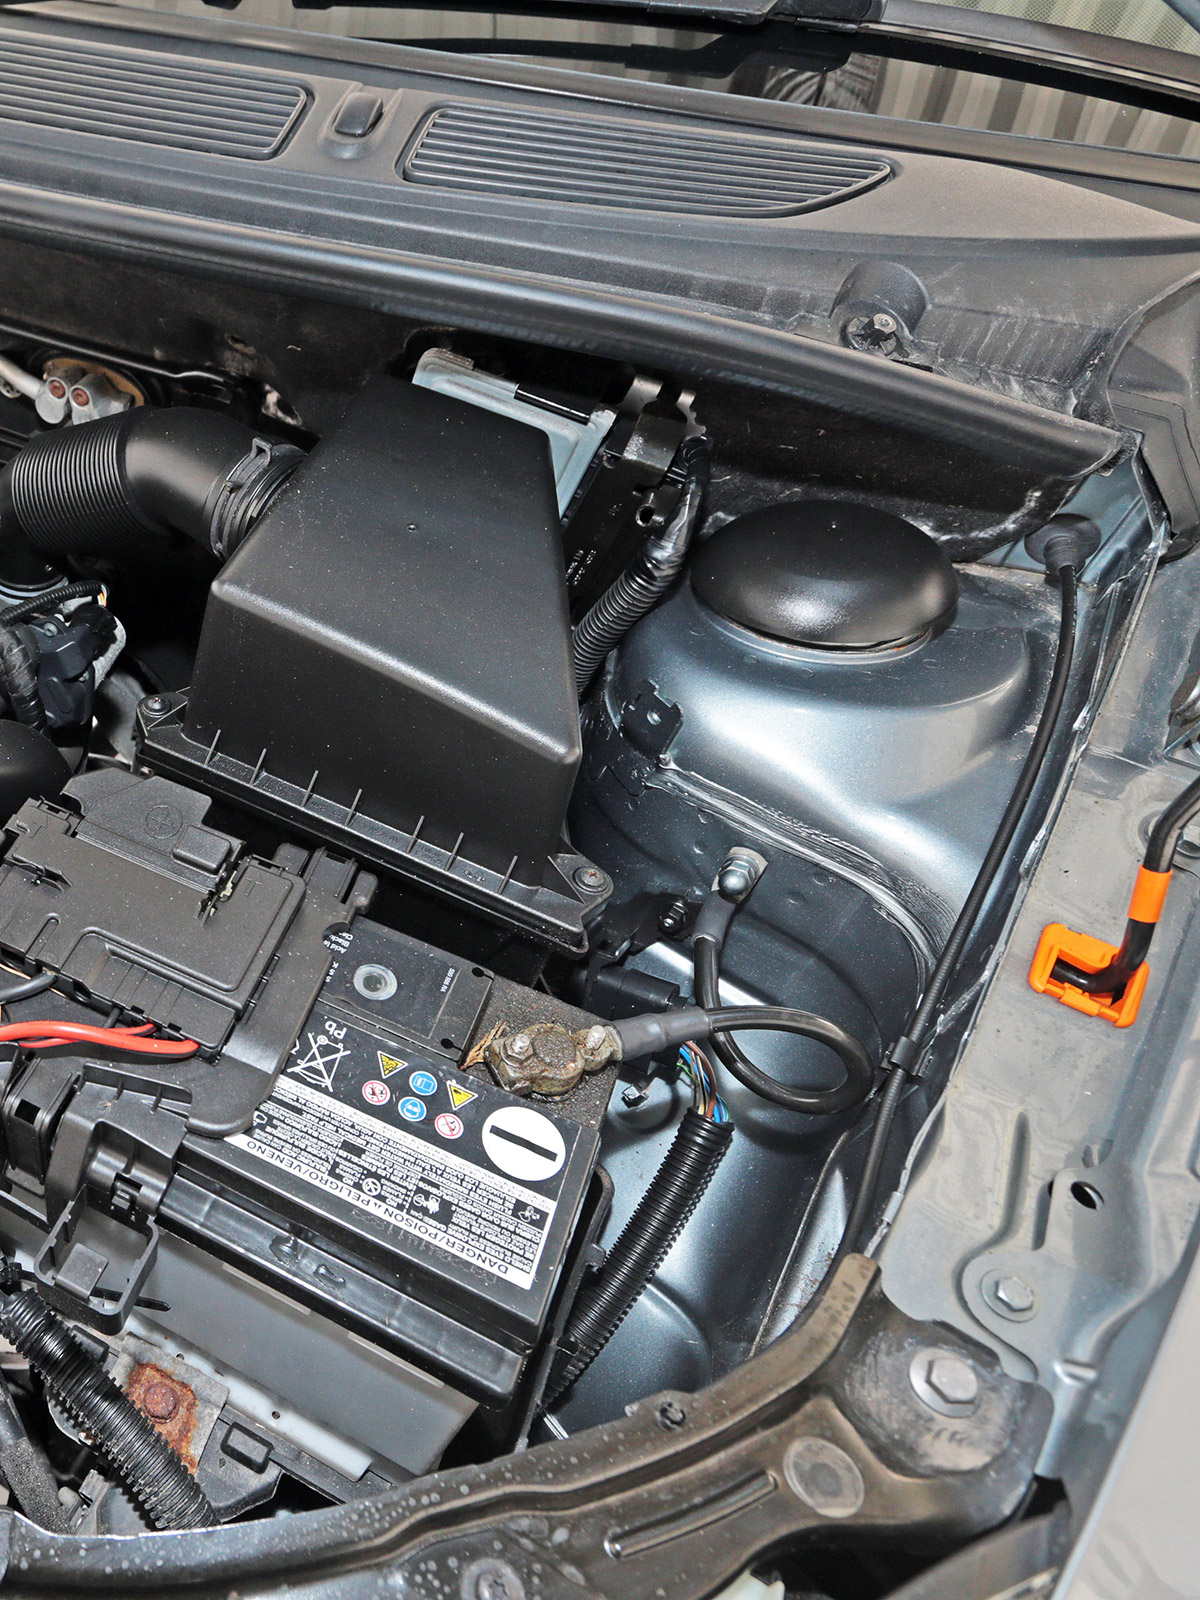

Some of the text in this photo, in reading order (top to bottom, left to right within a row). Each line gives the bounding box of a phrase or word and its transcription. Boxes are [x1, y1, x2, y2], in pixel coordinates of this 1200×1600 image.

[325, 1020, 347, 1040] Pb
[245, 1139, 371, 1206] PELIGRO/VENENO
[382, 1207, 508, 1274] DANGER/POISON
